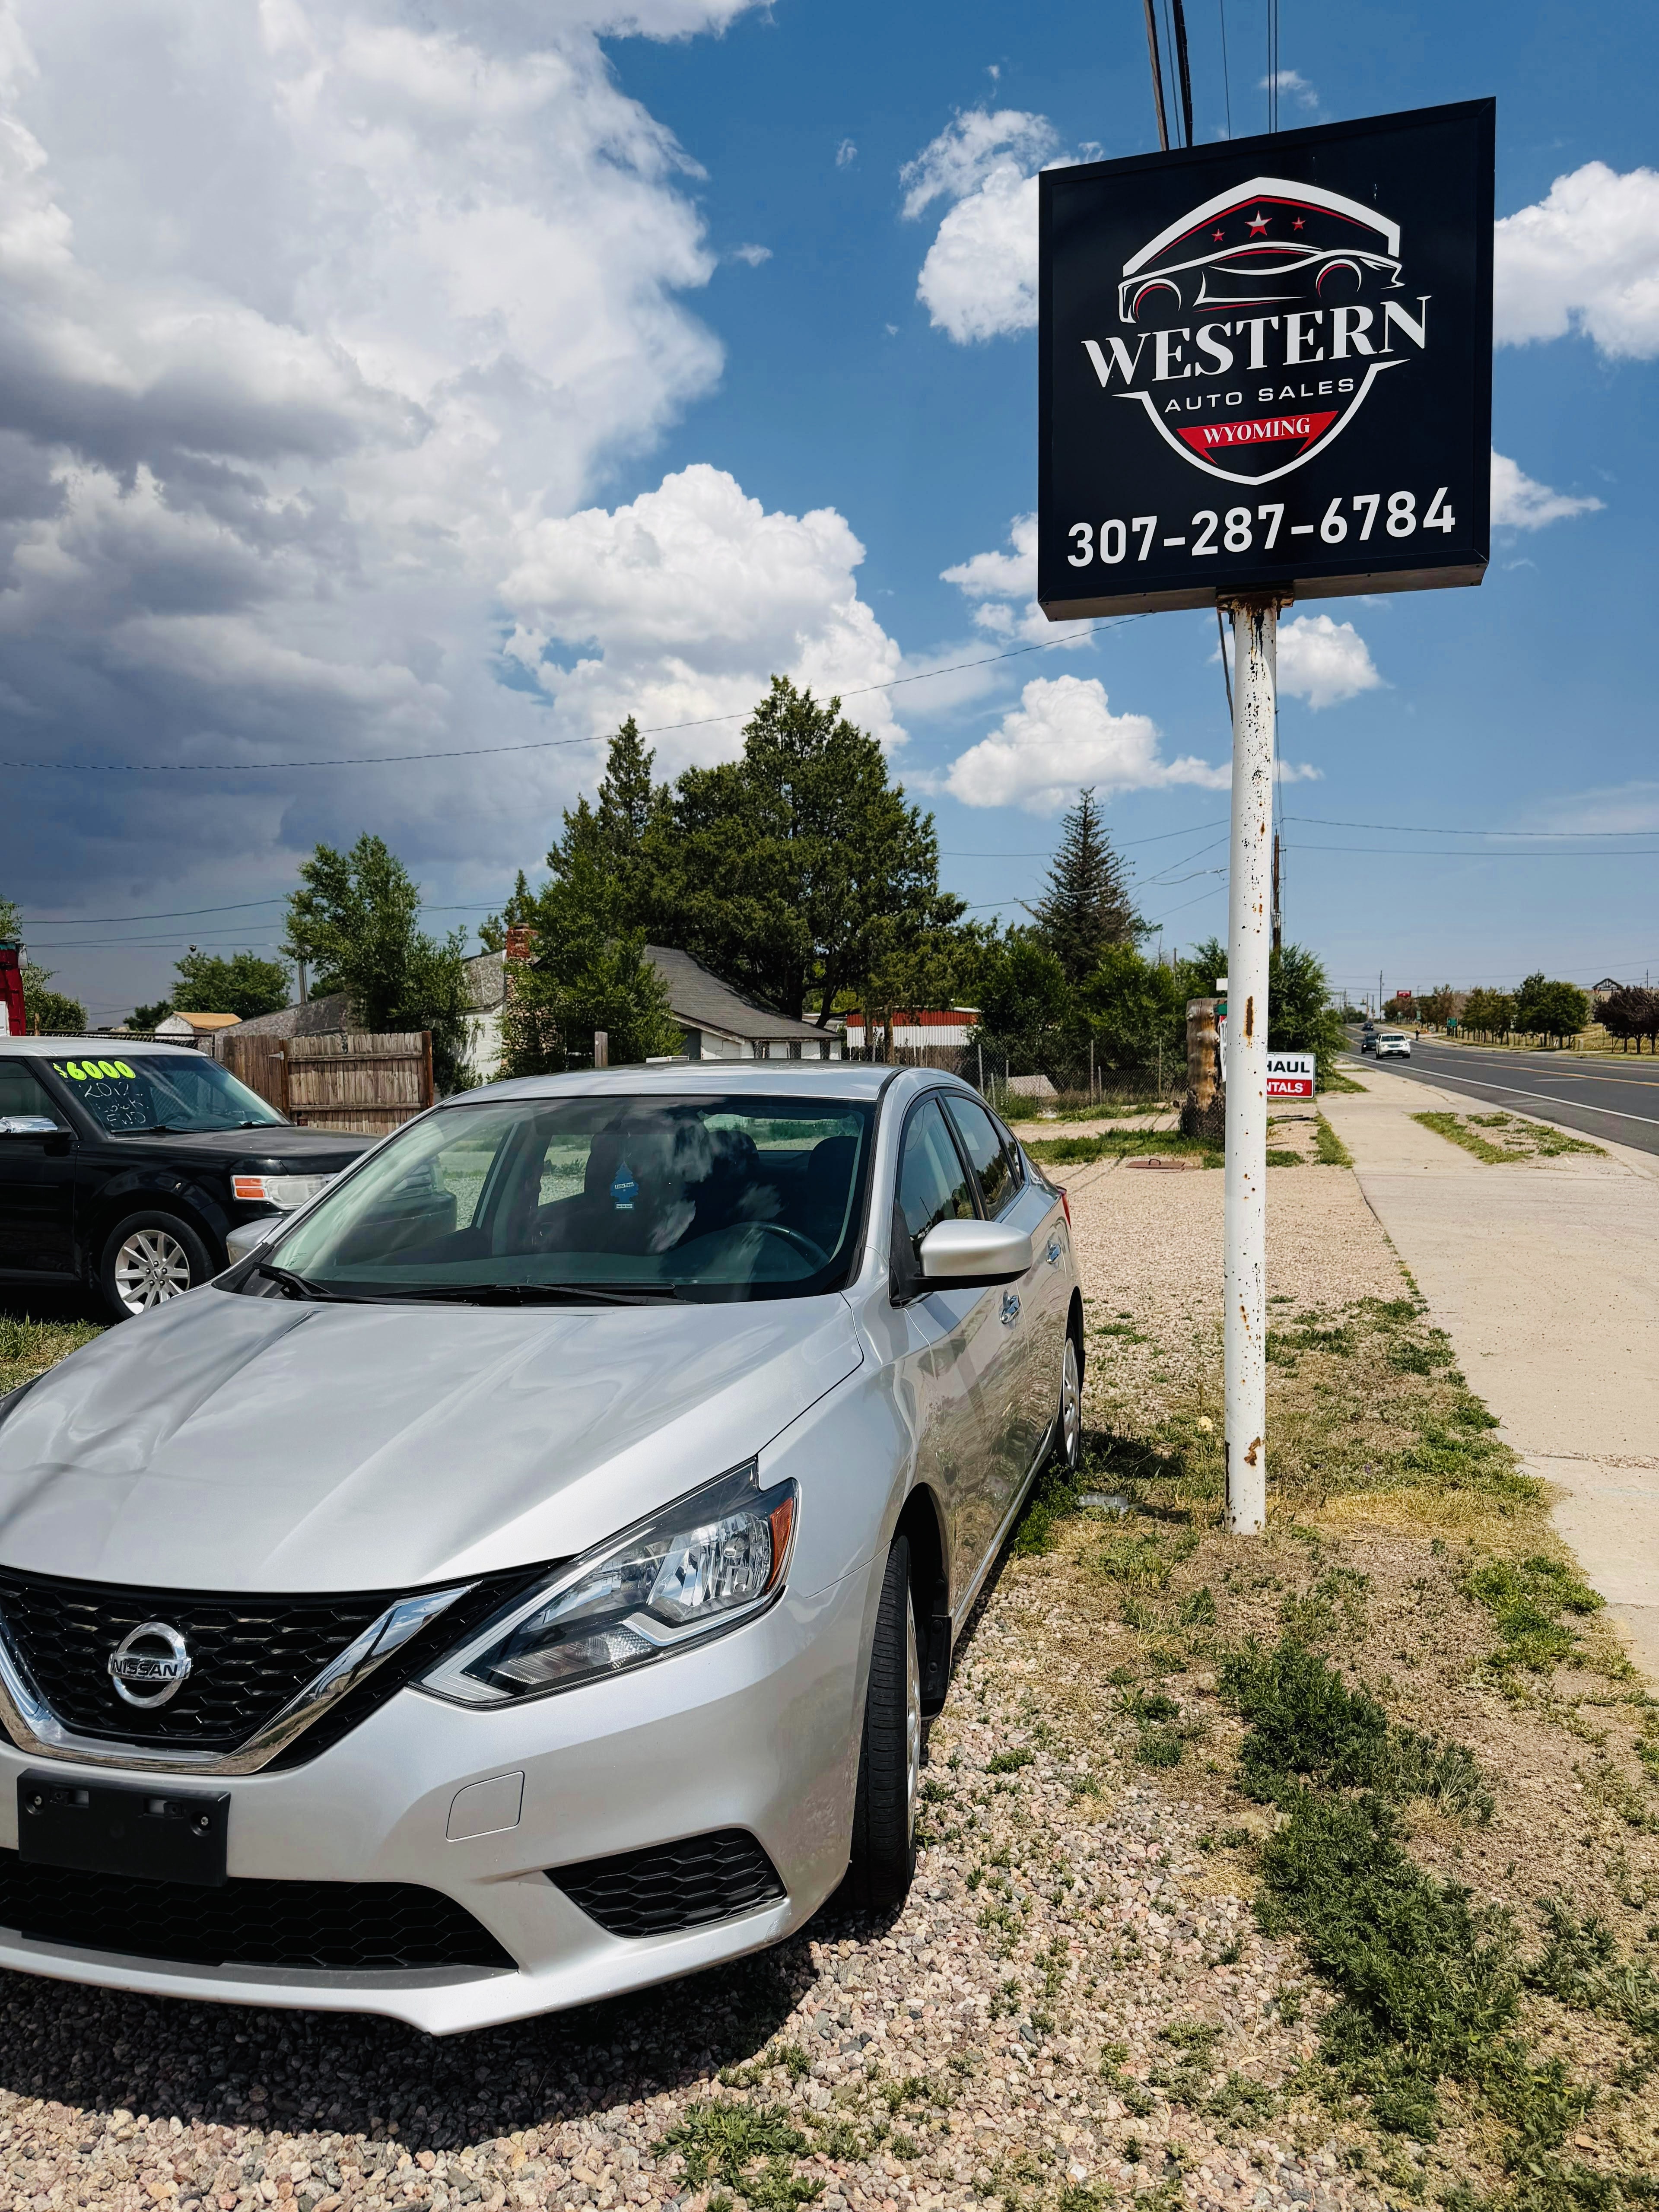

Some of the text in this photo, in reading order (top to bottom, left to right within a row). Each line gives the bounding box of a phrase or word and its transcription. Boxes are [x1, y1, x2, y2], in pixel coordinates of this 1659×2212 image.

[1081, 295, 1432, 388] WESTERN
[1164, 378, 1354, 413] AUTO SALES
[1202, 417, 1311, 445] WYOMING
[1067, 486, 1456, 568] 307-287-6784
[52, 1060, 136, 1081] $6000
[112, 1658, 178, 1676] NISSAN
